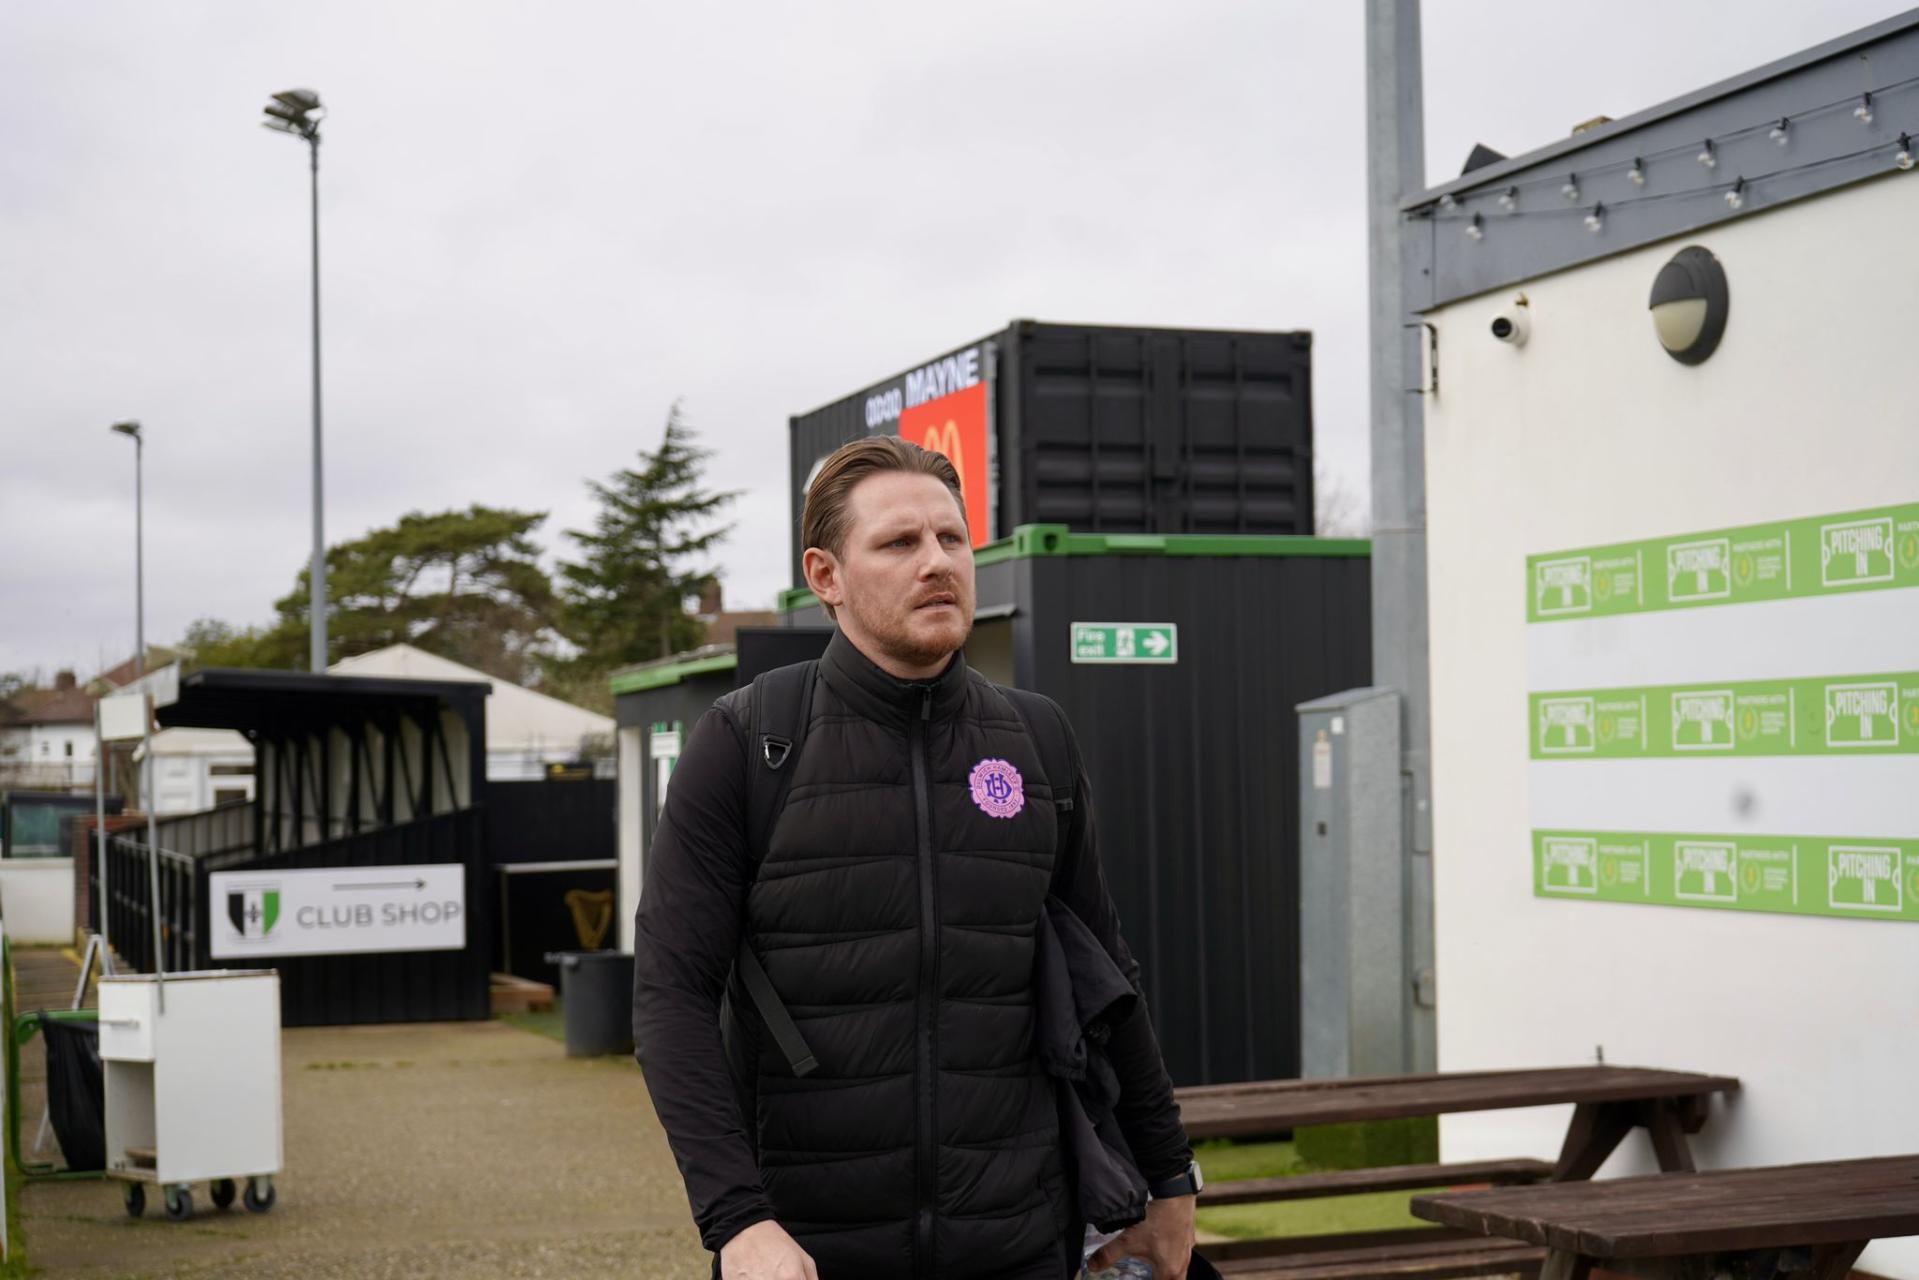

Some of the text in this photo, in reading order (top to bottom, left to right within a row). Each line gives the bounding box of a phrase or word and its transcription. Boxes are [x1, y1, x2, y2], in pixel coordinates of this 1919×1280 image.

[905, 348, 979, 409] MAYNE
[1831, 525, 1882, 554] PITCHING
[1676, 546, 1719, 573] PITCHING
[1856, 550, 1868, 577] IN
[1077, 628, 1106, 643] Fire
[1078, 645, 1105, 657] exit
[1680, 698, 1724, 721] PITCHING
[1836, 690, 1887, 716] PITCHING
[1860, 714, 1873, 738] IN
[1683, 847, 1728, 872] PITCHING
[1839, 853, 1890, 879] PITCHING
[1863, 878, 1876, 903] IN
[296, 900, 461, 929] CLUB SHOP
